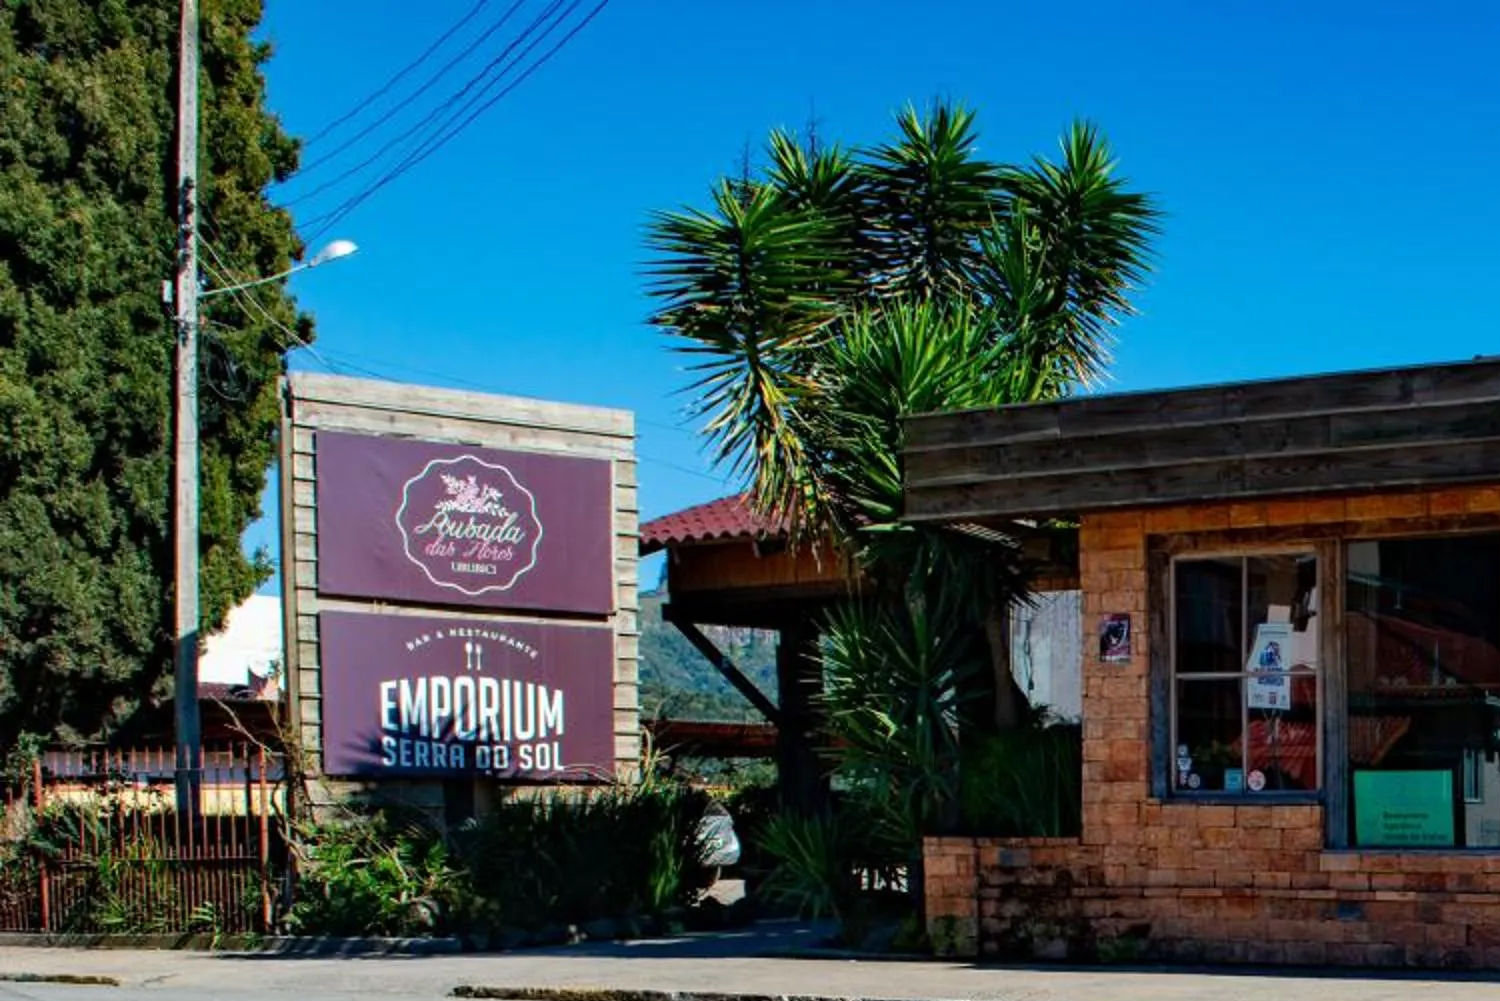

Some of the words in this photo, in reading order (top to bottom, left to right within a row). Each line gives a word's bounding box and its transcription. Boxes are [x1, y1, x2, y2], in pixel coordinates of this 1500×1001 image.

[425, 538, 455, 556] das
[462, 540, 513, 560] Flores
[449, 627, 538, 660] RESTAURANTE
[380, 675, 565, 742] EMPORIUM
[382, 736, 466, 768] SERRA
[476, 745, 509, 769] DO
[519, 741, 566, 771] SOL
